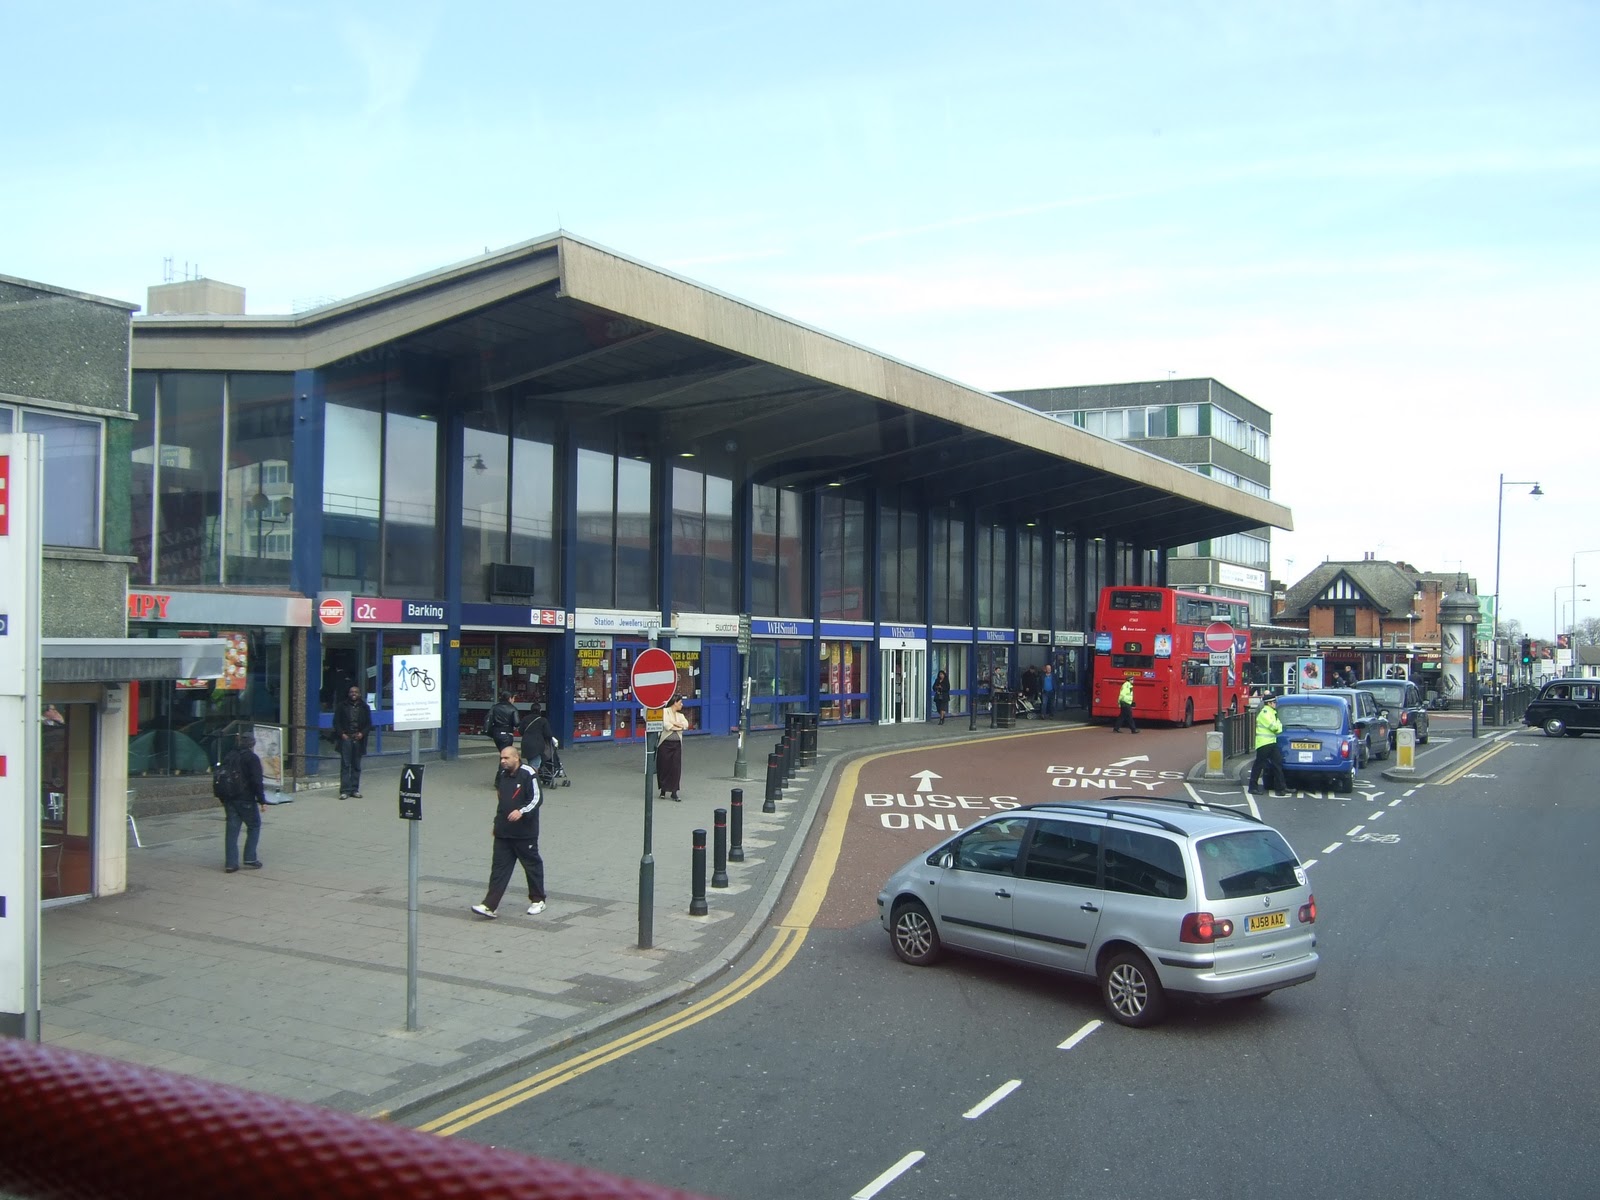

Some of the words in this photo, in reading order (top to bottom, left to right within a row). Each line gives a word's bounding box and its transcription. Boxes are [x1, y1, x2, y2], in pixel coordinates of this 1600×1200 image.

[357, 604, 376, 619] c2c
[408, 604, 443, 620] Barking
[594, 617, 614, 626] Station
[619, 618, 642, 627] Jewellers
[768, 622, 798, 634] WHSmith
[892, 627, 915, 638] WHSmith
[986, 631, 1006, 641] WHSmith
[578, 639, 601, 648] swatch
[471, 648, 491, 657] CLOCK
[507, 648, 545, 657] JEWELLERY
[578, 649, 605, 658] JEWELLERY
[687, 652, 699, 660] CLOCK
[512, 658, 540, 667] REPAIRS
[581, 659, 600, 667] REPAIRS
[1046, 765, 1184, 780] BUSES
[1051, 777, 1165, 791] ONLY
[864, 793, 1022, 810] BUSES
[1250, 916, 1269, 930] AJ58
[1270, 913, 1284, 926] AAZ
